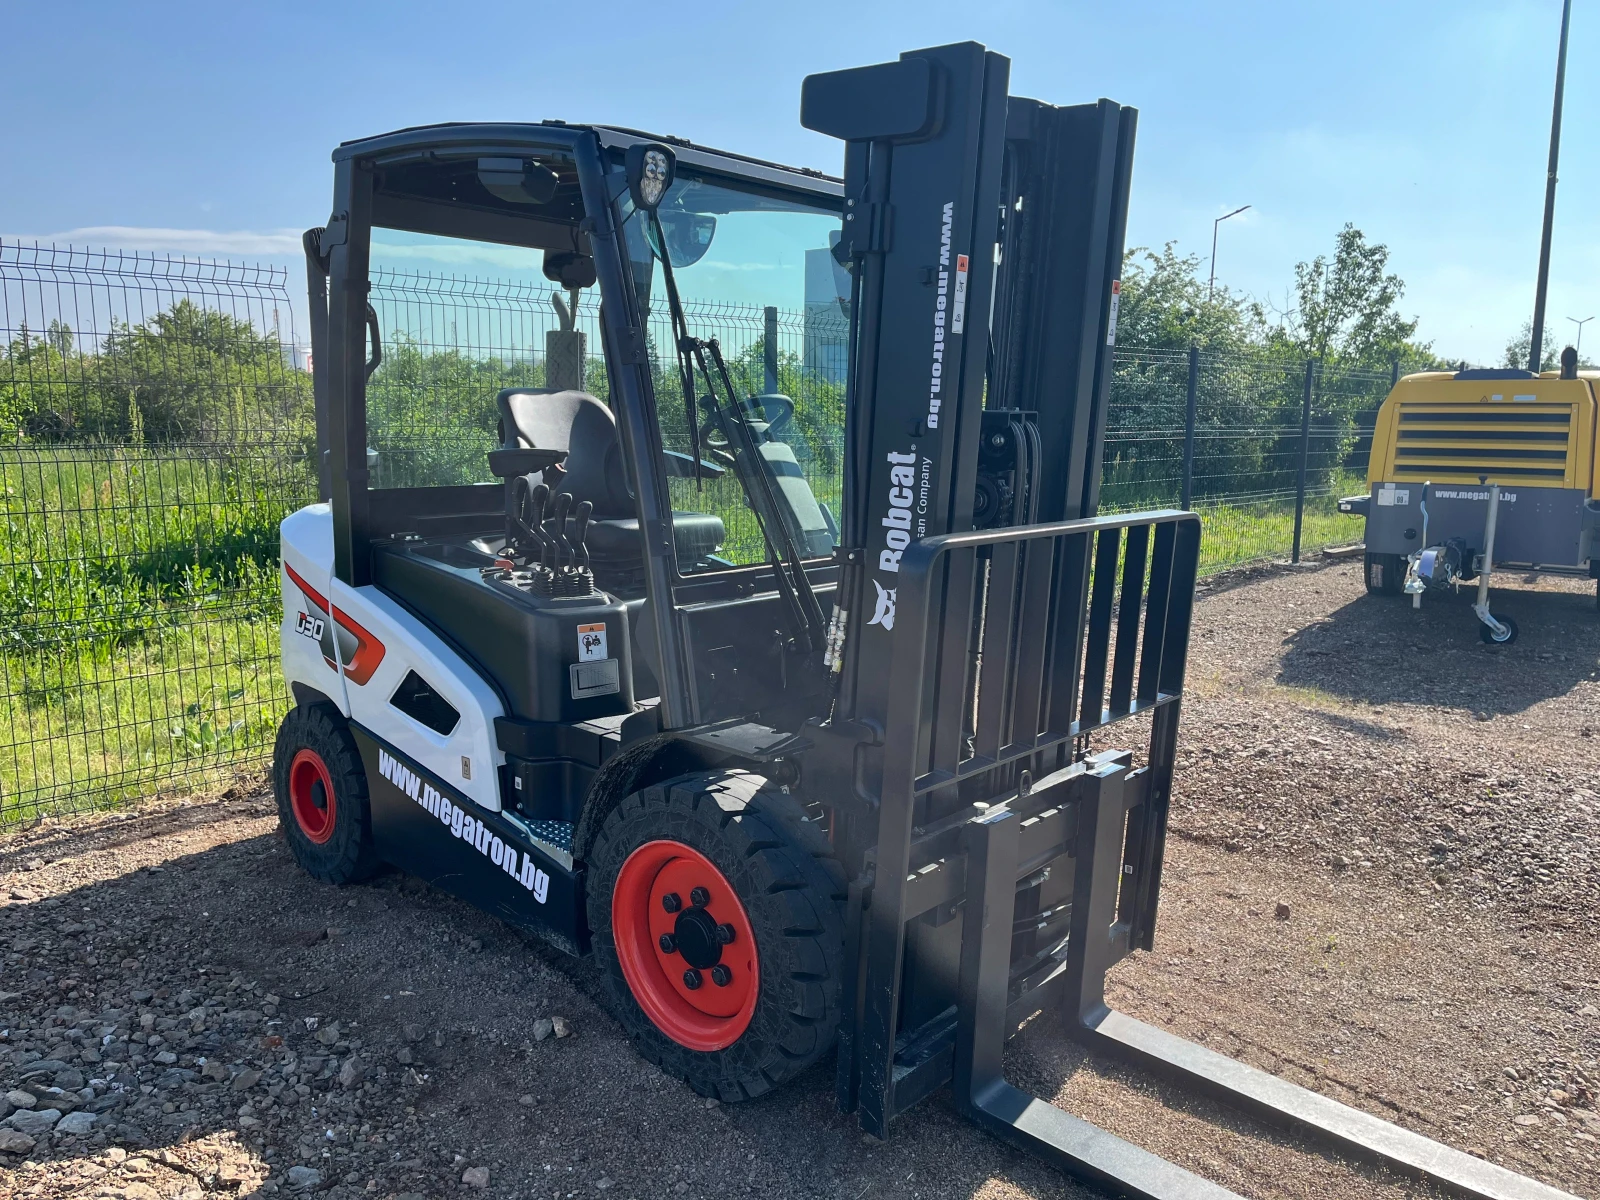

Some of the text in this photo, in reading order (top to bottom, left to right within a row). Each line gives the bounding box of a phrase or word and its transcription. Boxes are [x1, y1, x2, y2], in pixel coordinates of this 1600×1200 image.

[927, 201, 953, 428] www.megatron.bg
[917, 456, 932, 515] Company
[295, 611, 325, 641] D30
[379, 748, 550, 904] www.megatron.bg
